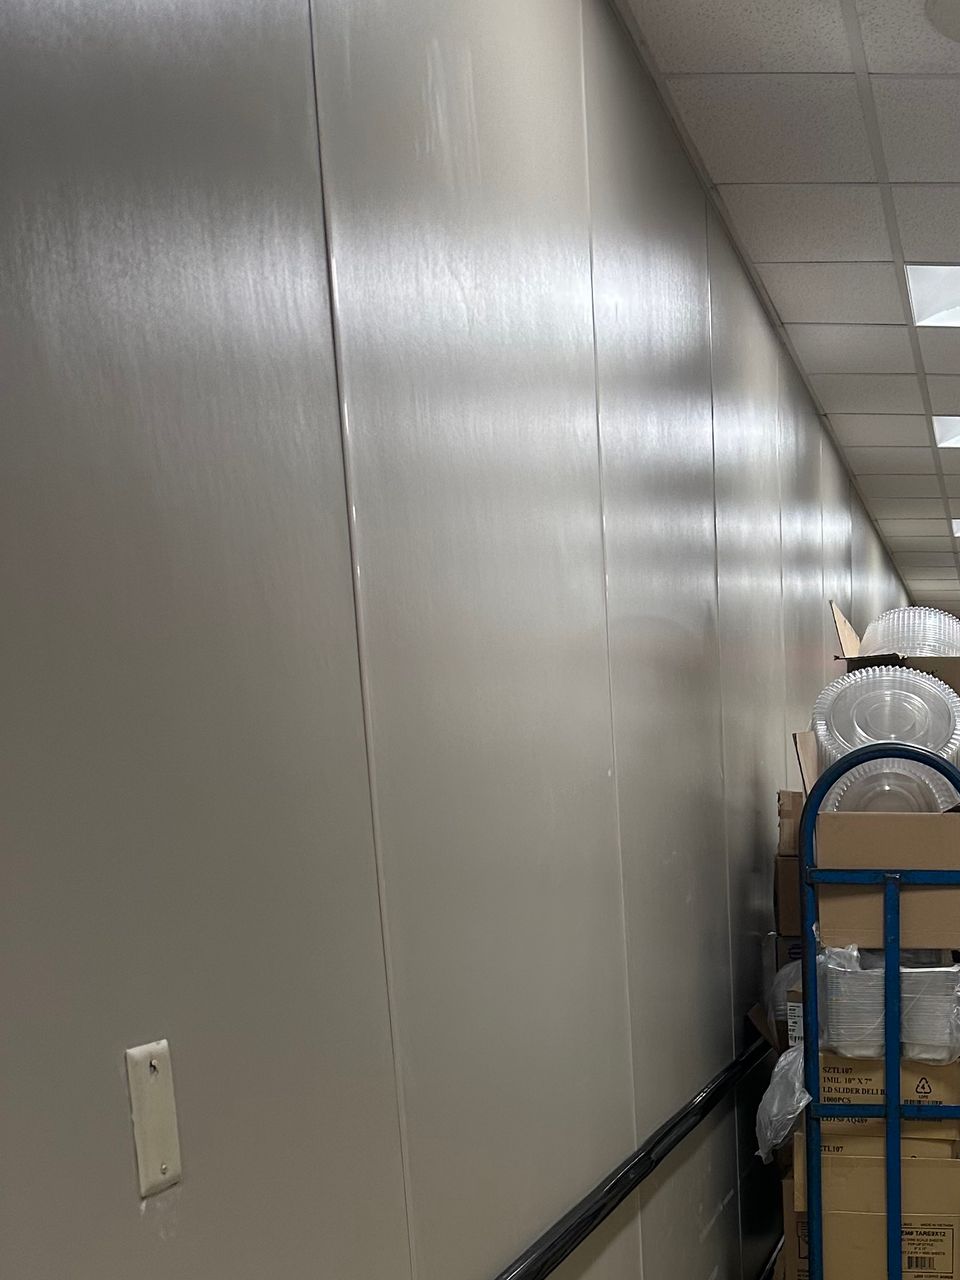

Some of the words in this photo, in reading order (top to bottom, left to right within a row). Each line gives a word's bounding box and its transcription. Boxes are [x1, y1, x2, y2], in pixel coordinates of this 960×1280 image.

[823, 1086, 833, 1094] LD
[833, 1087, 860, 1095] SLIDER
[862, 1088, 879, 1096] DELI
